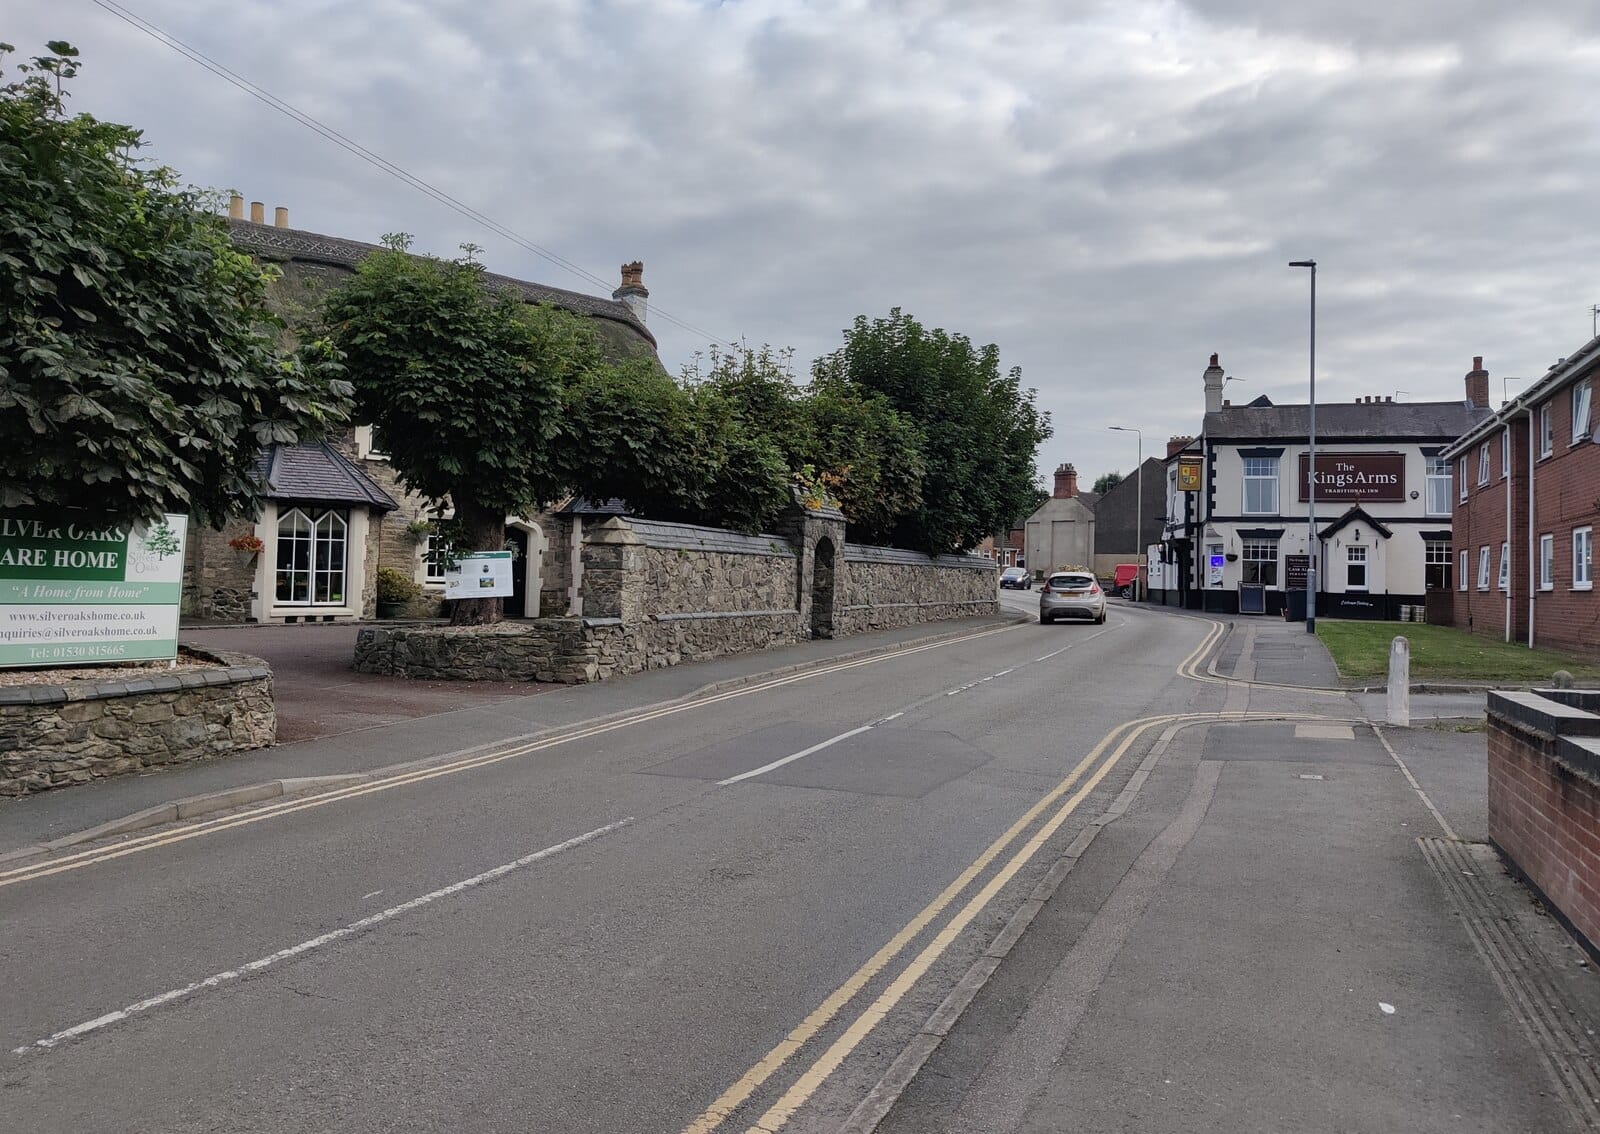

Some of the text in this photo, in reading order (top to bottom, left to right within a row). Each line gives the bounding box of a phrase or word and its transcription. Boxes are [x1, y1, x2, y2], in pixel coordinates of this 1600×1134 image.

[1335, 462, 1355, 472] The
[53, 550, 119, 569] HOME
[33, 585, 72, 598] Home
[72, 585, 103, 601] from
[9, 611, 146, 621] www.silveroakshome.co.uk
[28, 645, 125, 659] Tel: 01530 815665
